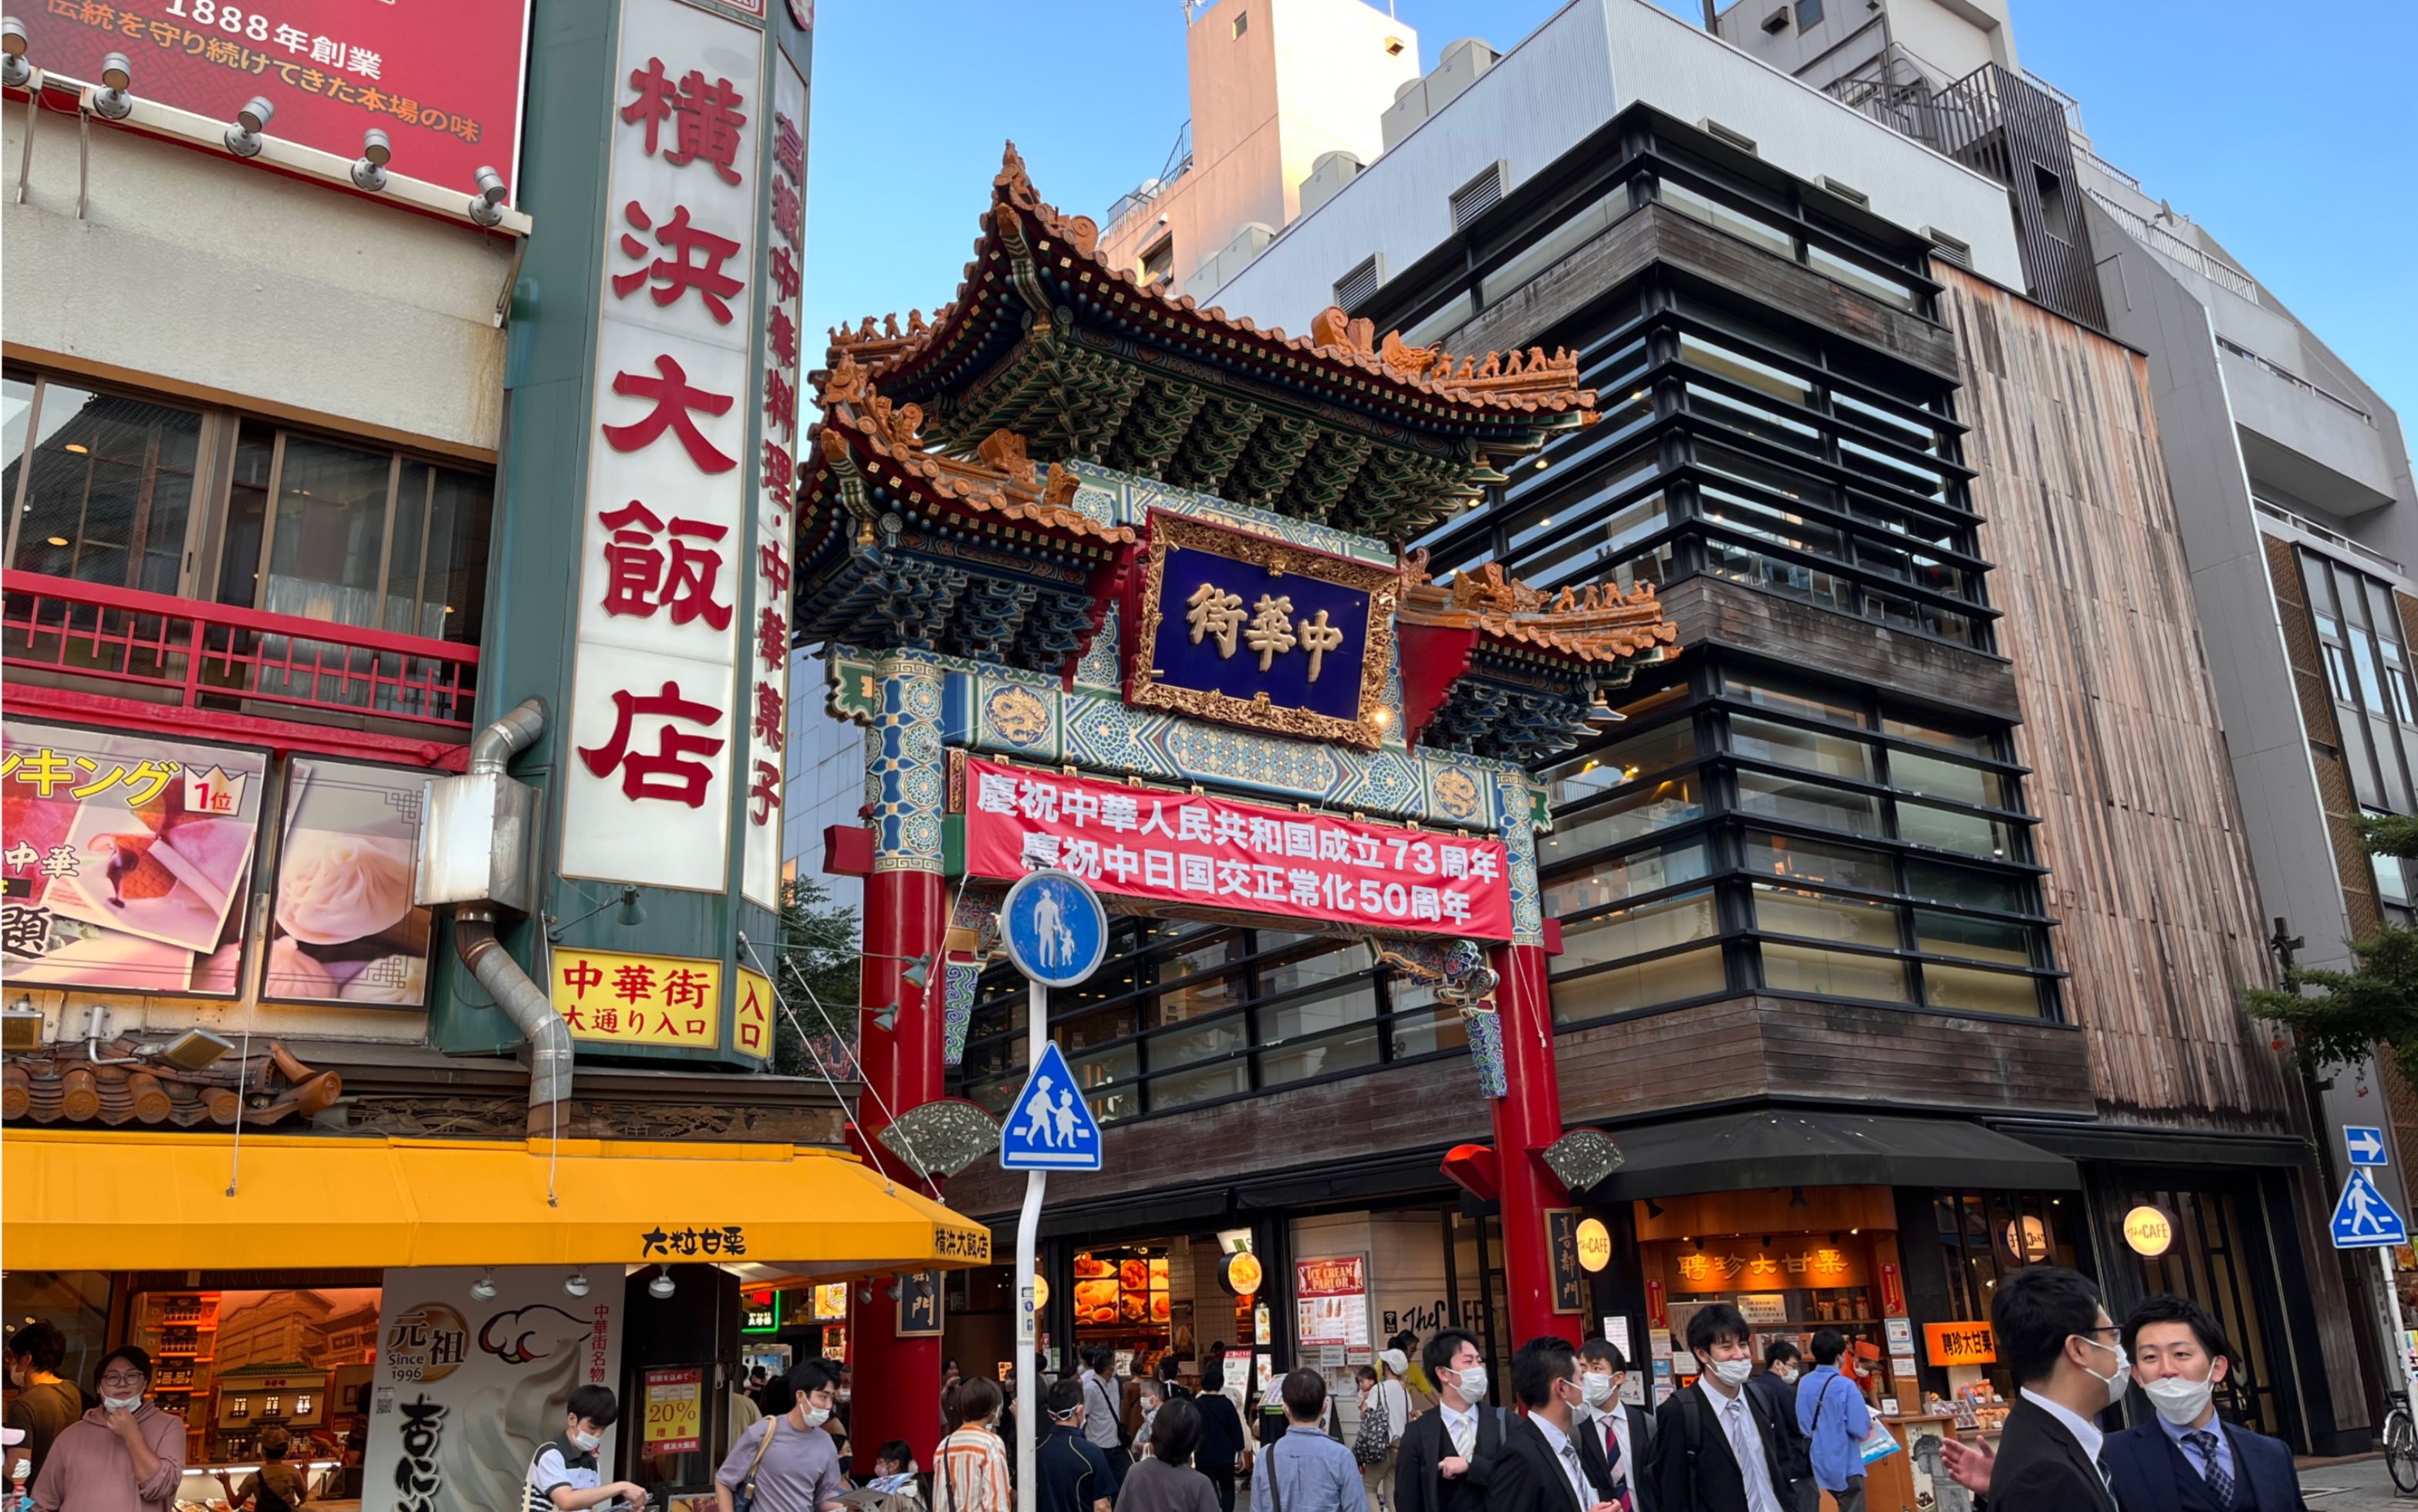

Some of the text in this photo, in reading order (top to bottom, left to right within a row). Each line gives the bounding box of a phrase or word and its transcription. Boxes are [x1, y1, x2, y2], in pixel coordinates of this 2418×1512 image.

[165, 0, 383, 79] 1888年創業
[46, 0, 482, 144] 伝統を守り続けてきた本場の味
[577, 57, 747, 809] 横浜大飯店
[1186, 582, 1344, 683] 中華街
[194, 783, 232, 812] 1位
[977, 772, 1499, 884] 慶祝中華人民共和国成立73周年
[3, 840, 80, 879] 中華
[563, 960, 711, 1010] 中華街
[562, 1004, 706, 1037] 大通り入口
[738, 980, 765, 1049] 入口
[642, 1227, 746, 1257] 大粒甘栗
[934, 1229, 988, 1259] 横浜大飯店
[1307, 1266, 1353, 1281] ICE CREAM
[1677, 1249, 1849, 1281] 聘珍大甘栗
[1312, 1277, 1349, 1290] PARLOR
[390, 1311, 464, 1366] 元祖
[589, 1304, 609, 1382] 中華街名物
[388, 1353, 424, 1366] Since
[391, 1367, 422, 1382] 1996
[649, 1400, 696, 1423] 20%
